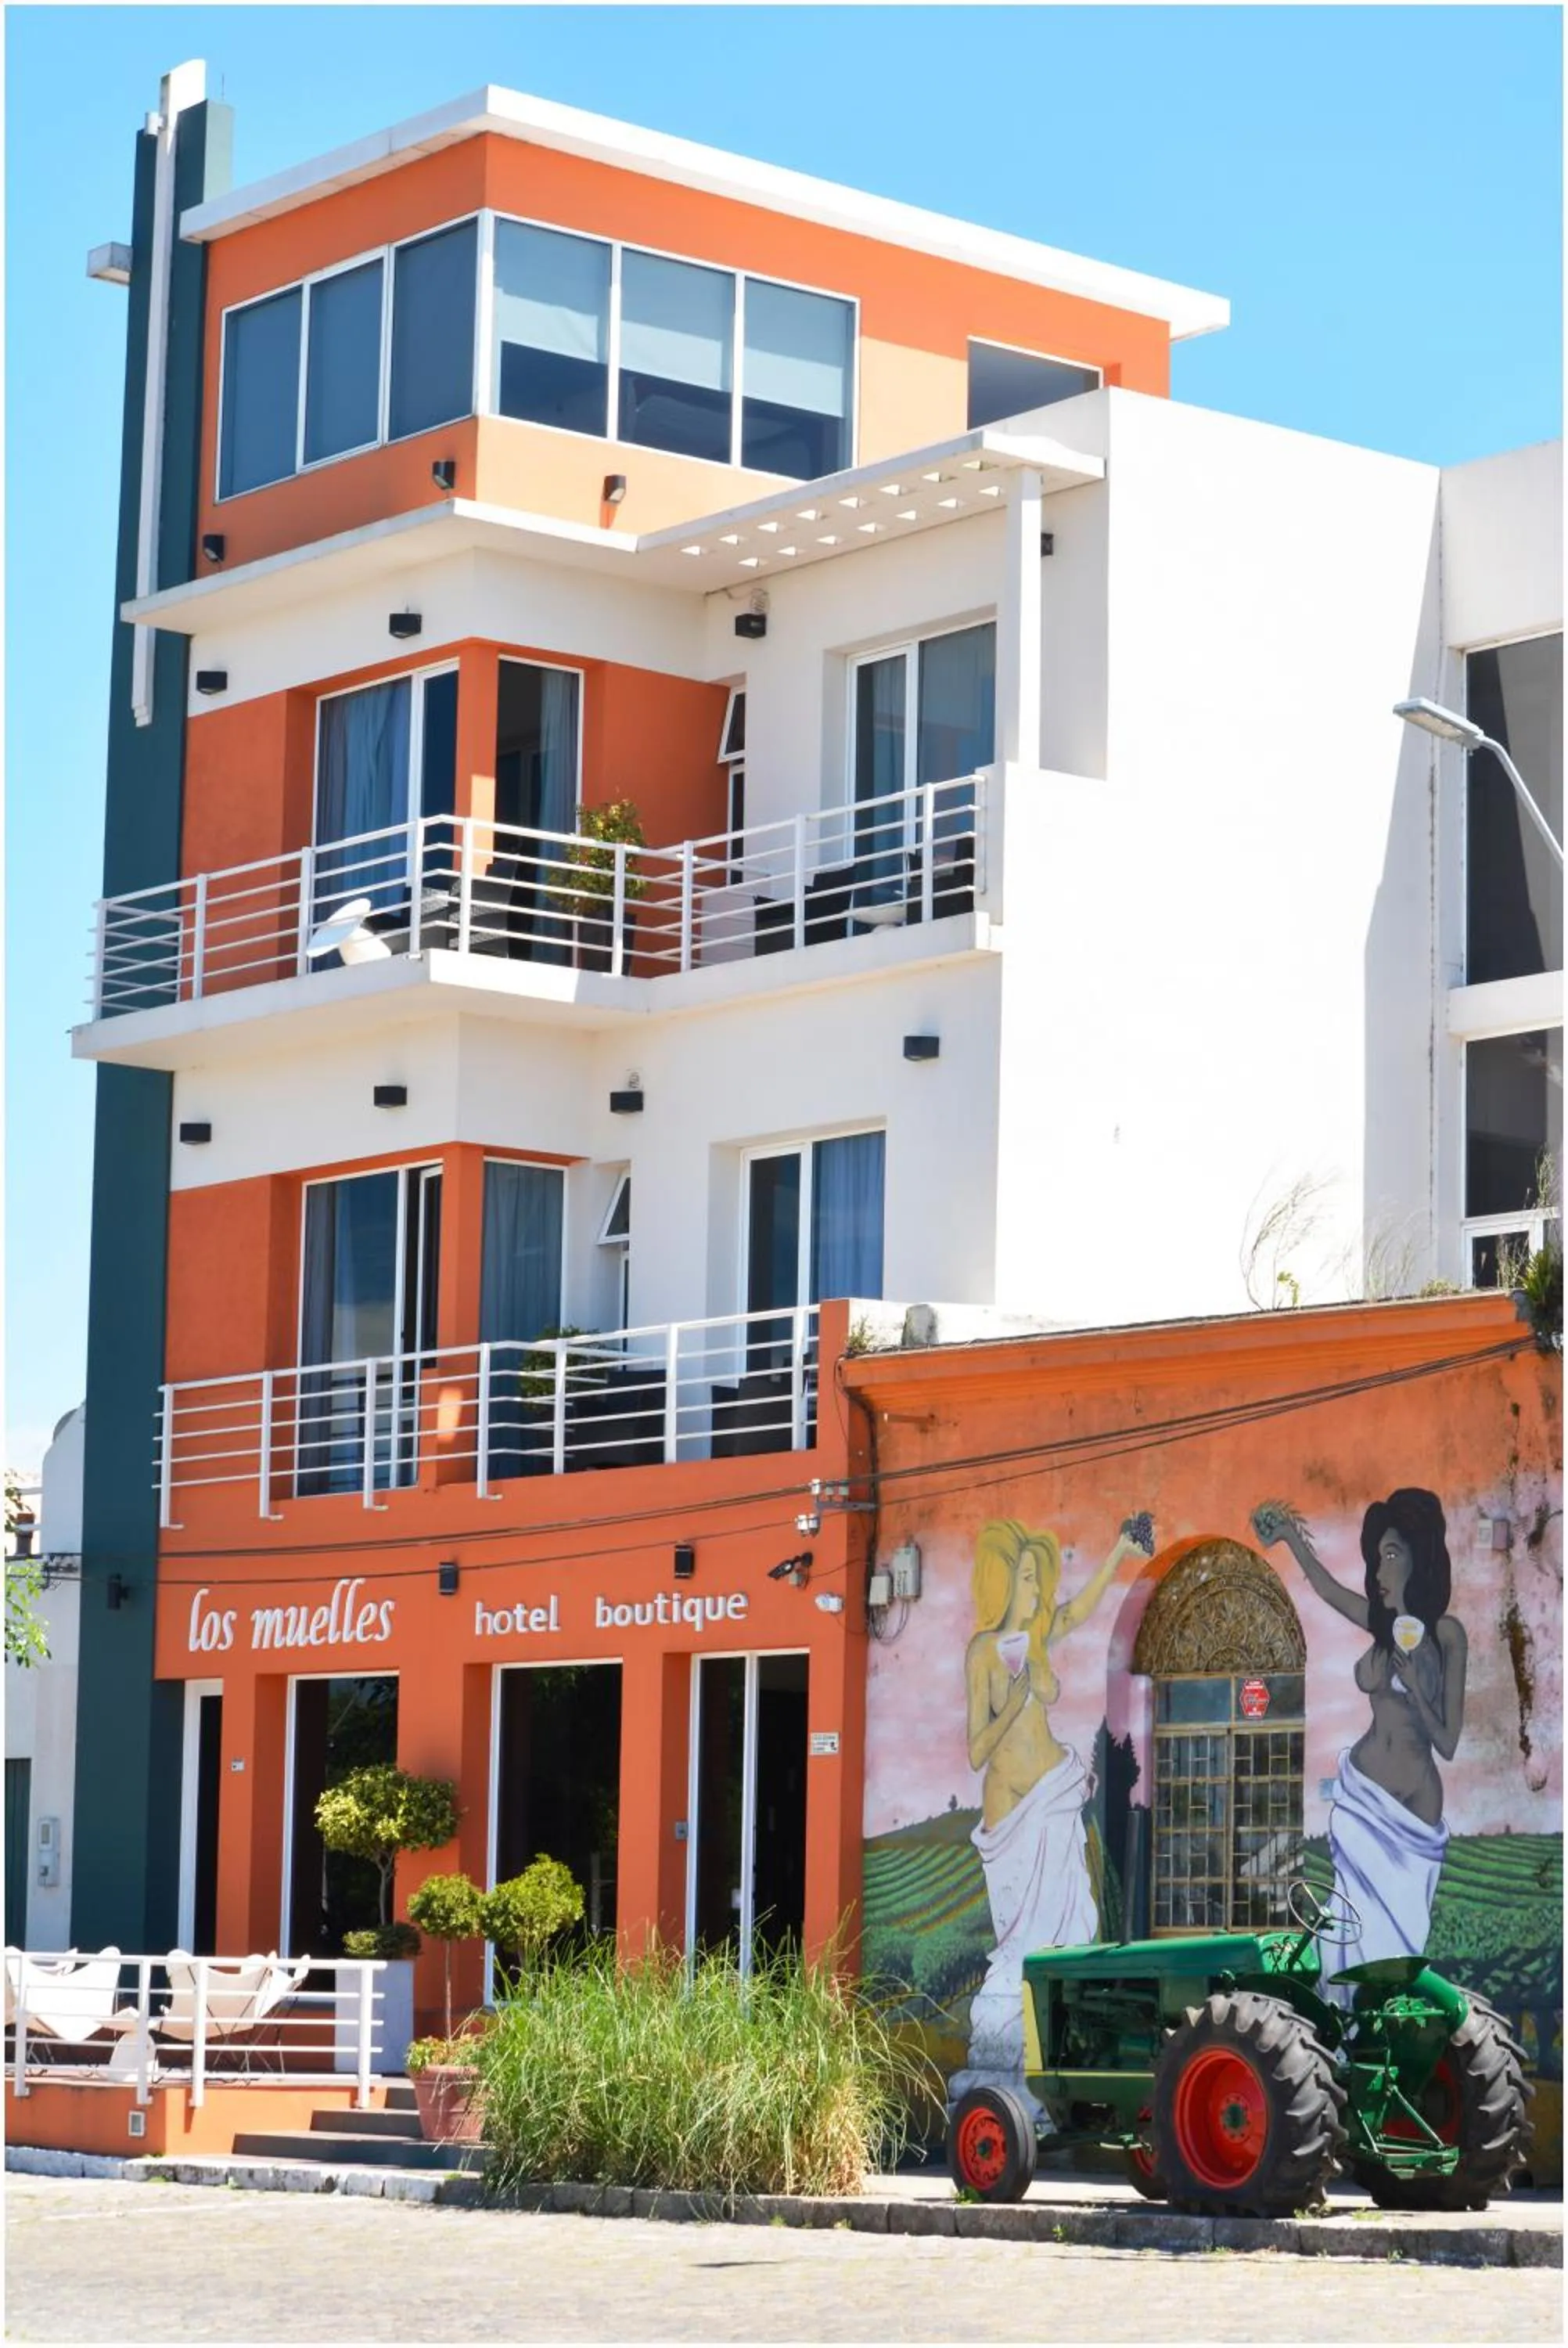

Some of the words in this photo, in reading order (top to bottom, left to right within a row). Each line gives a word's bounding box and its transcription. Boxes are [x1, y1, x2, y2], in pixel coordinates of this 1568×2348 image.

[189, 1588, 237, 1651] los
[250, 1578, 395, 1649] muelles
[475, 1594, 561, 1636] hotel
[595, 1591, 748, 1632] boutique
